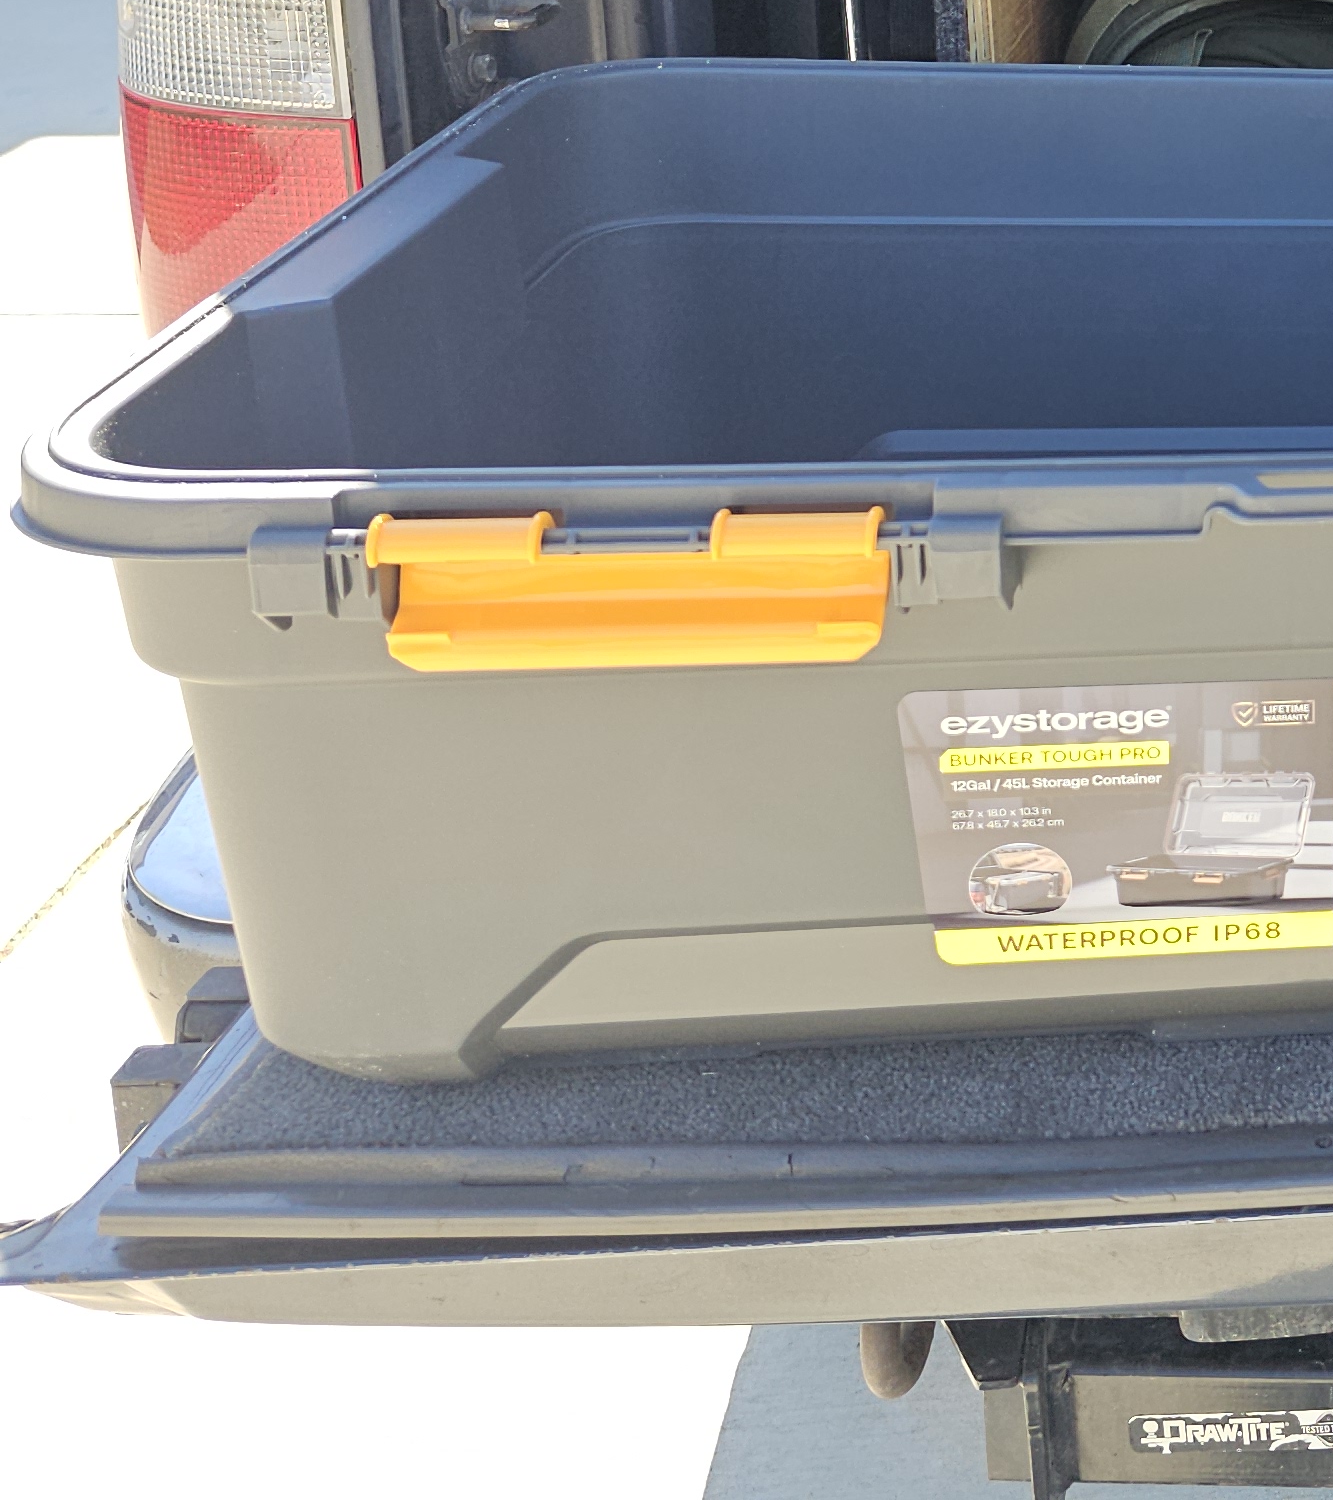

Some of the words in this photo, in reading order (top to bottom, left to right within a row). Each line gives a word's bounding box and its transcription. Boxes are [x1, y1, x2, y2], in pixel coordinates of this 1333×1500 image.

[1262, 703, 1310, 714] LIFETIME
[940, 708, 1170, 740] ezystorage
[1263, 713, 1309, 723] WARRANTY
[949, 750, 1034, 768] BUNKER
[1041, 748, 1113, 764] TOUGH
[1119, 746, 1162, 761] PRO
[950, 779, 992, 792] 12Gal
[1003, 777, 1031, 790] 45L
[1032, 775, 1090, 791] Storage
[1091, 772, 1163, 787] Container
[951, 808, 975, 820] 26.7
[1019, 806, 1040, 817] 10.3
[1041, 805, 1052, 815] in
[1046, 817, 1065, 827] cm
[997, 925, 1201, 953] WATERPROOF
[1213, 921, 1283, 943] IP68
[1300, 1425, 1331, 1434] TESTED
